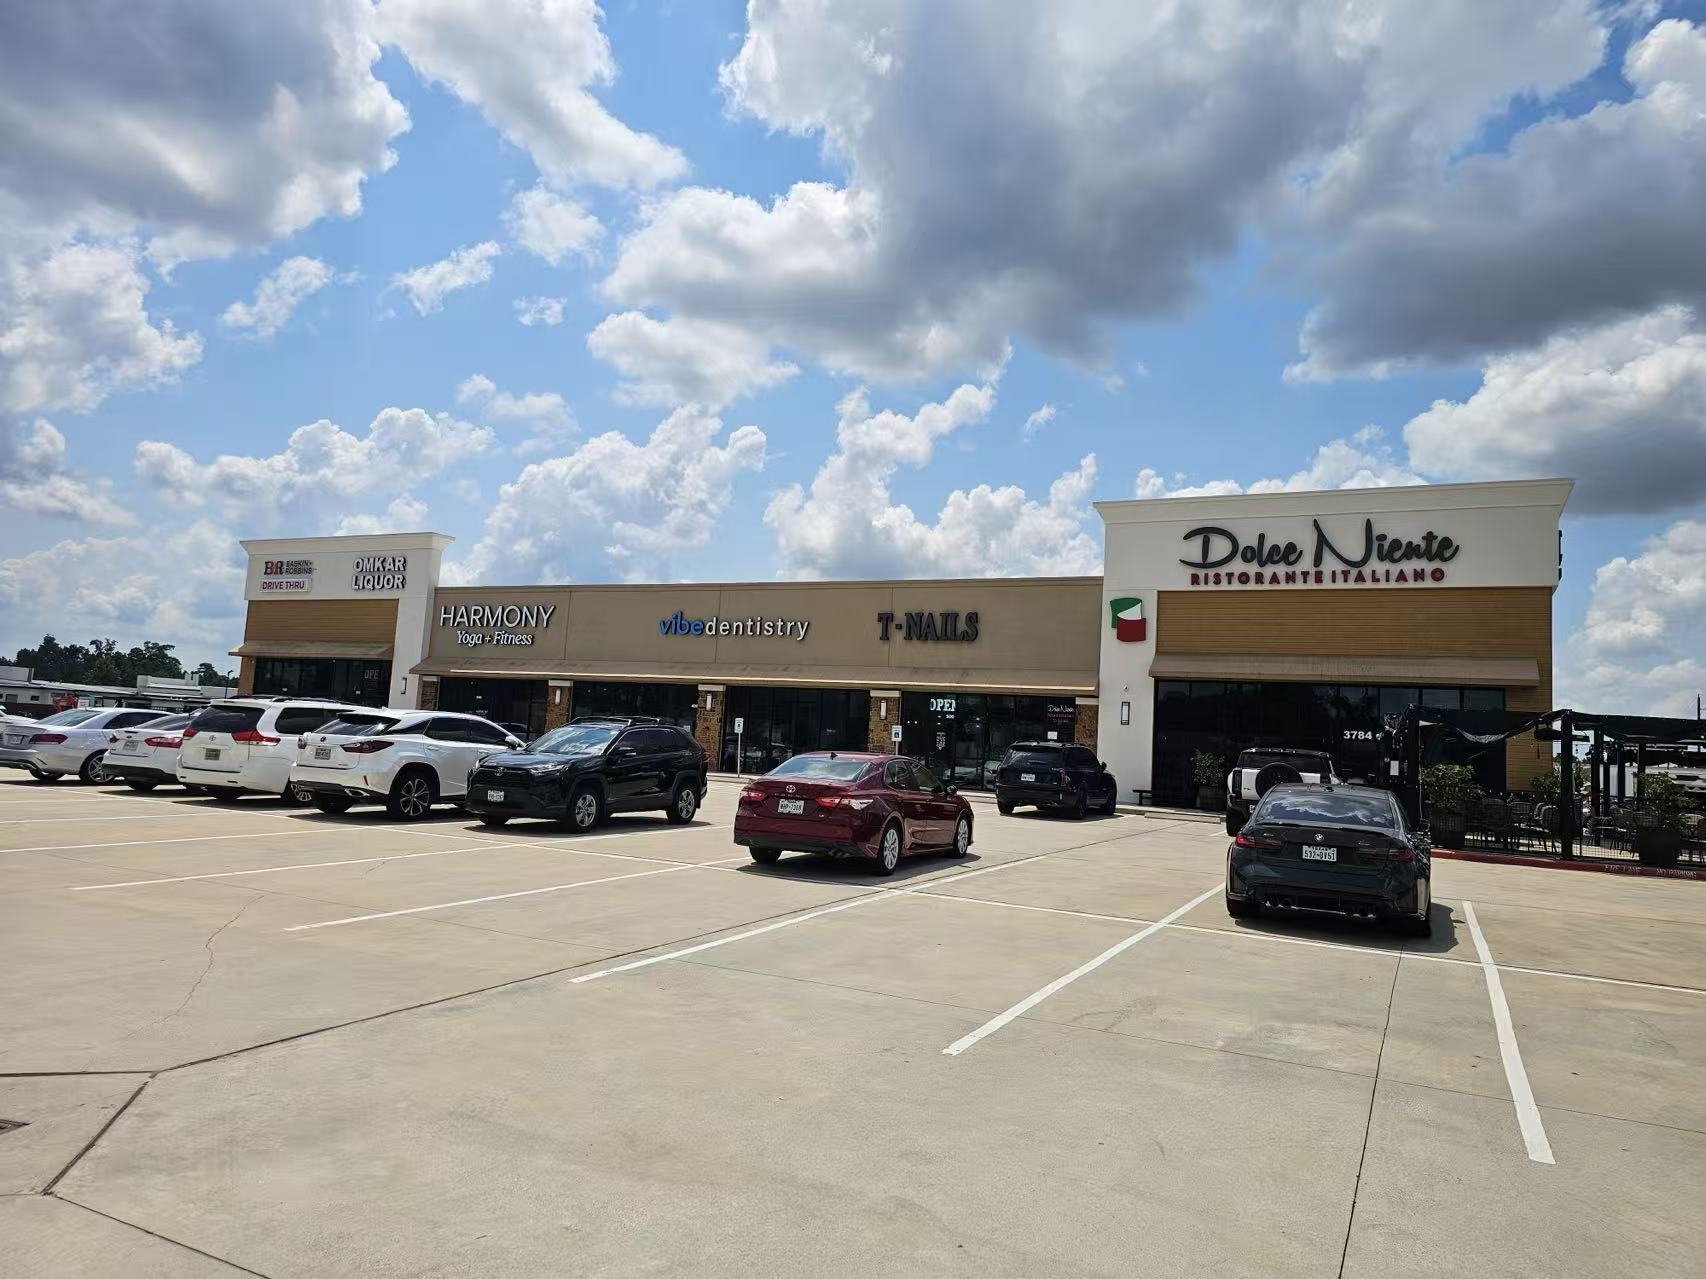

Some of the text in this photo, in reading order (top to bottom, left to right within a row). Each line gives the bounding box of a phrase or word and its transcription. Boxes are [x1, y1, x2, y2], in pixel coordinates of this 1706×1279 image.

[1179, 518, 1460, 569] Dolce Niente
[264, 561, 284, 575] BR
[353, 557, 406, 572] OMKAR
[352, 575, 405, 590] LIQUOR
[1190, 567, 1445, 586] RISTORANTE ITALIANO
[262, 581, 305, 590] DRIVE THRU
[440, 605, 556, 628] HARMONY
[876, 612, 979, 641] T-NAILS
[457, 630, 484, 647] Yoga
[492, 631, 535, 646] Fitness
[1343, 730, 1372, 740] 3784
